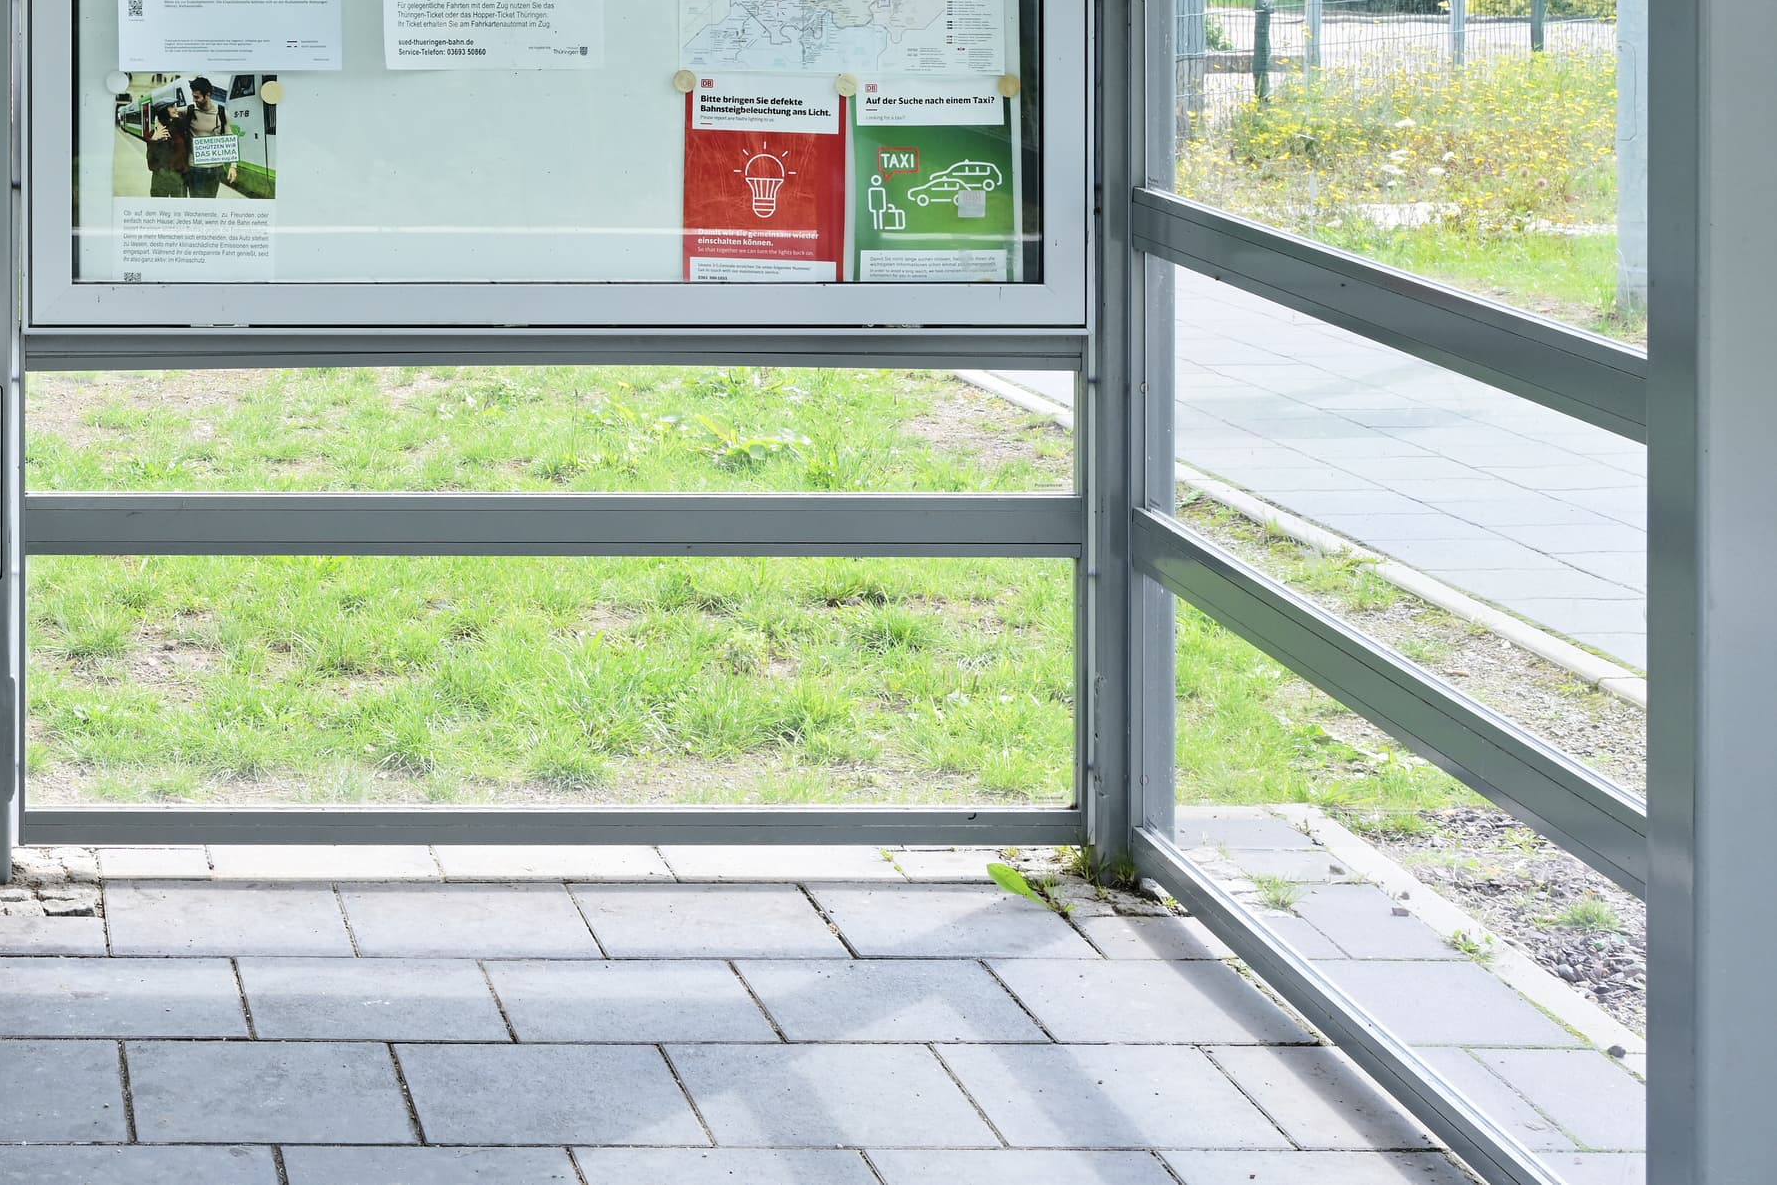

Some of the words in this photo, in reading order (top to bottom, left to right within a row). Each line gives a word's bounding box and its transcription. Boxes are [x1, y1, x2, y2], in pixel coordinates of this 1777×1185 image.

[398, 39, 474, 47] sued-thueringen-bahn.de
[700, 95, 721, 103] Bitte
[723, 96, 754, 105] bringen
[770, 97, 803, 106] defekte
[972, 96, 995, 104] Taxi?
[700, 105, 791, 116] Bahnsteigbeleuchtung
[194, 137, 236, 145] GEMEINSAM
[880, 152, 915, 169] TAXI
[747, 230, 791, 239] gemeinsam
[793, 230, 819, 239] wieder
[698, 237, 742, 245] einschalten
[743, 238, 774, 246] können.
